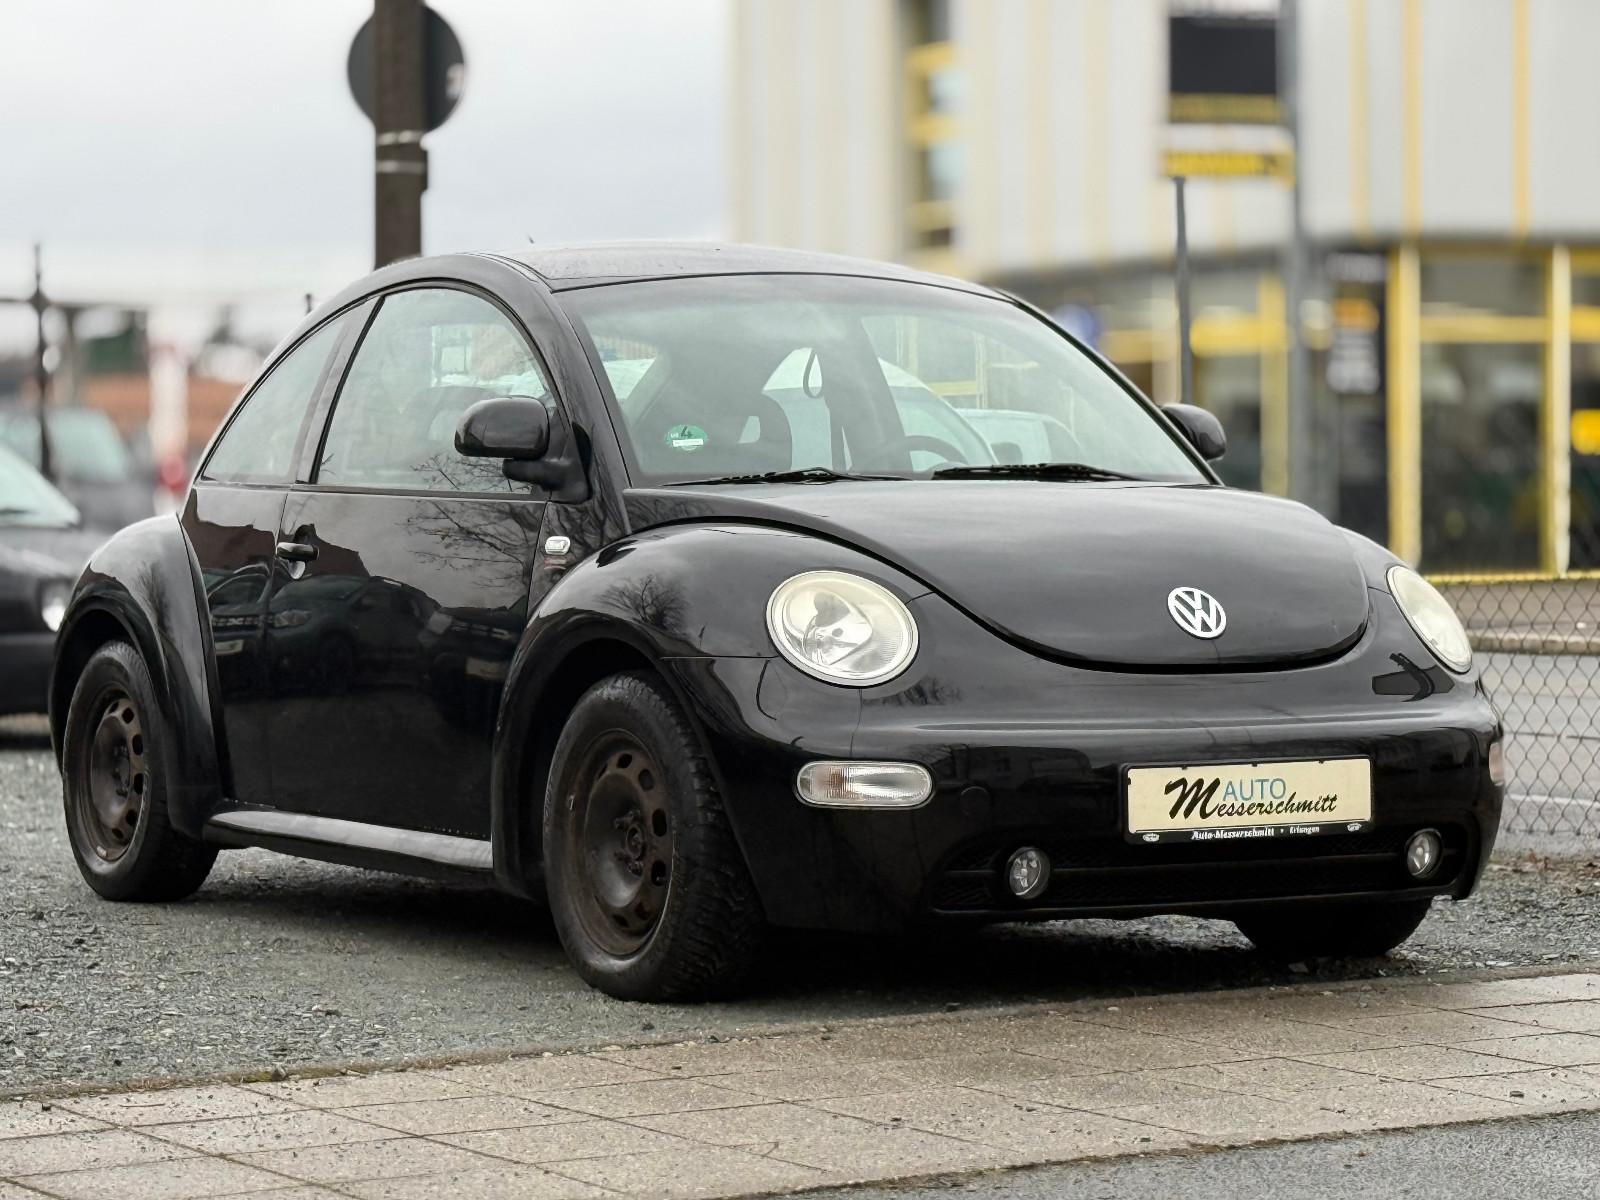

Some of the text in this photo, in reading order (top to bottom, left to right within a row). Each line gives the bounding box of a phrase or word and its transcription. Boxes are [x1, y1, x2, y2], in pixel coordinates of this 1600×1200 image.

[1168, 587, 1226, 638] VW
[1164, 777, 1337, 819] Messerschmitt
[1222, 778, 1286, 802] AUTO
